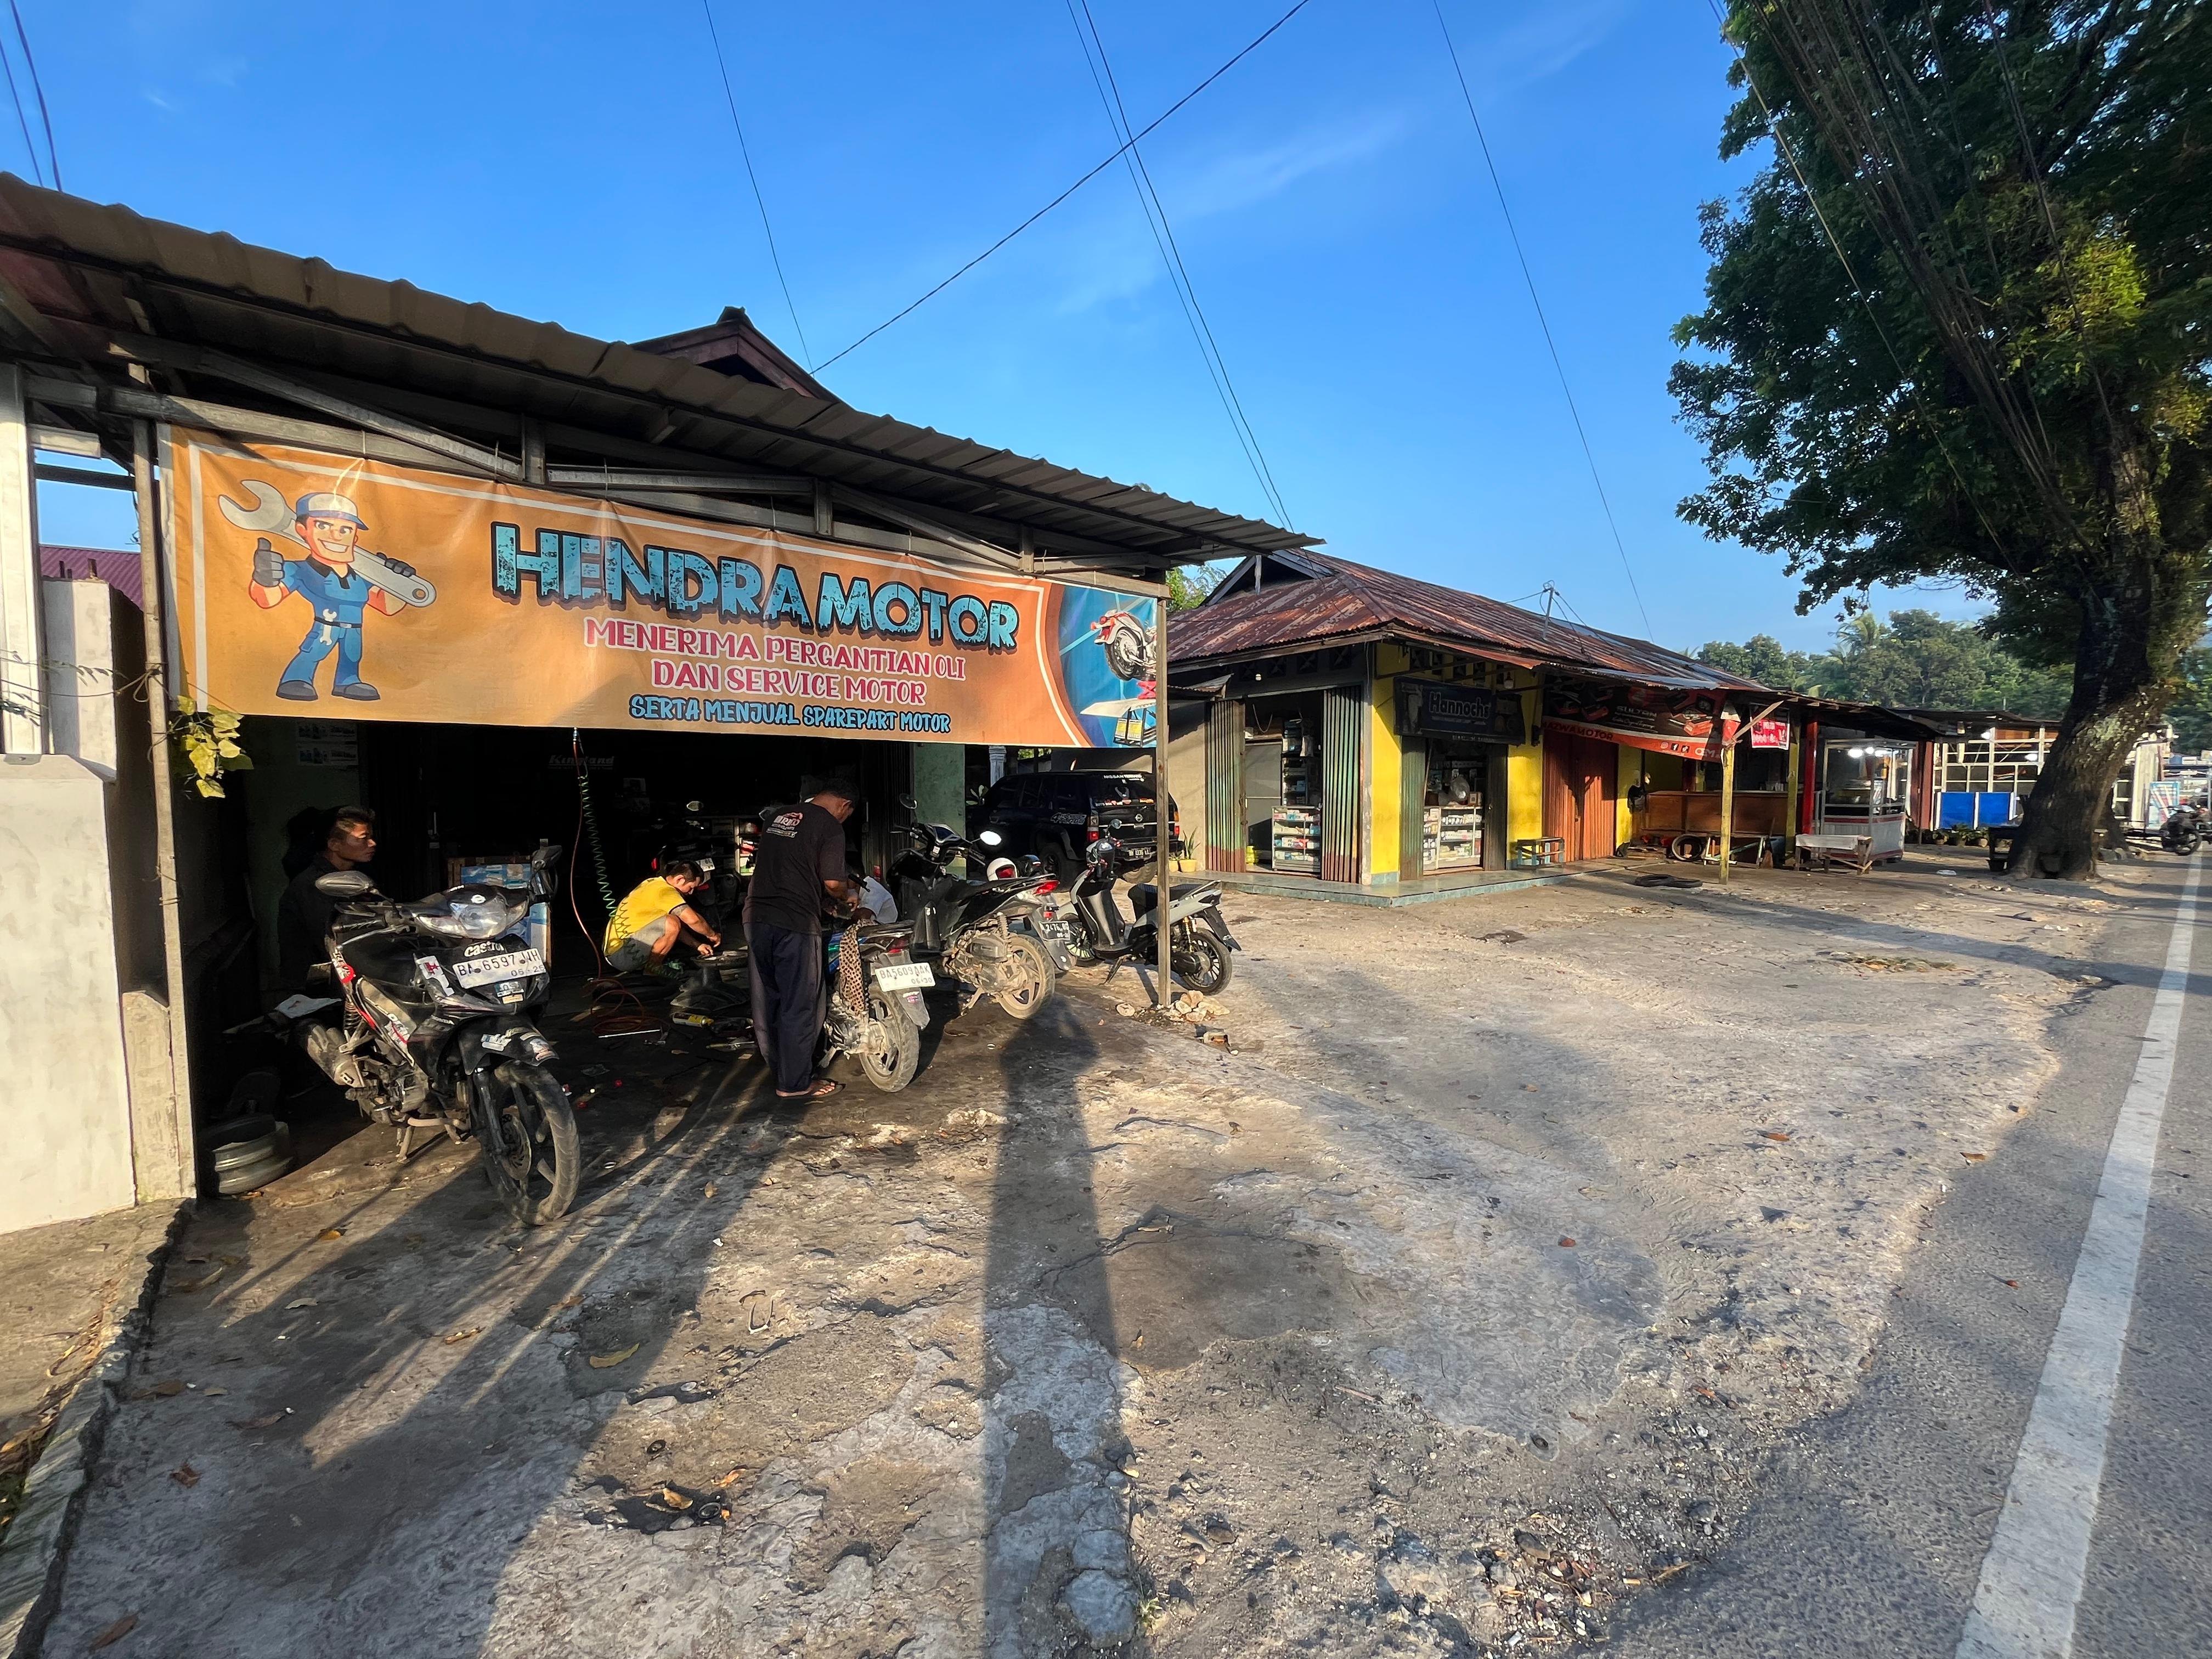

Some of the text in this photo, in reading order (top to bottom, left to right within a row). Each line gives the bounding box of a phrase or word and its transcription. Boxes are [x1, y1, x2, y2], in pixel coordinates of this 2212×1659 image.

[491, 522, 1019, 649] HENDRA MOTOR
[585, 618, 965, 680] MENERIMA PERGANTIAN OLI
[652, 660, 926, 705] DAN SERVICE MOTOR
[629, 694, 951, 733] SERTA MENJUAL SPAREPART MOTOR
[1429, 691, 1492, 719] Hannochs
[482, 955, 515, 970] 6597
